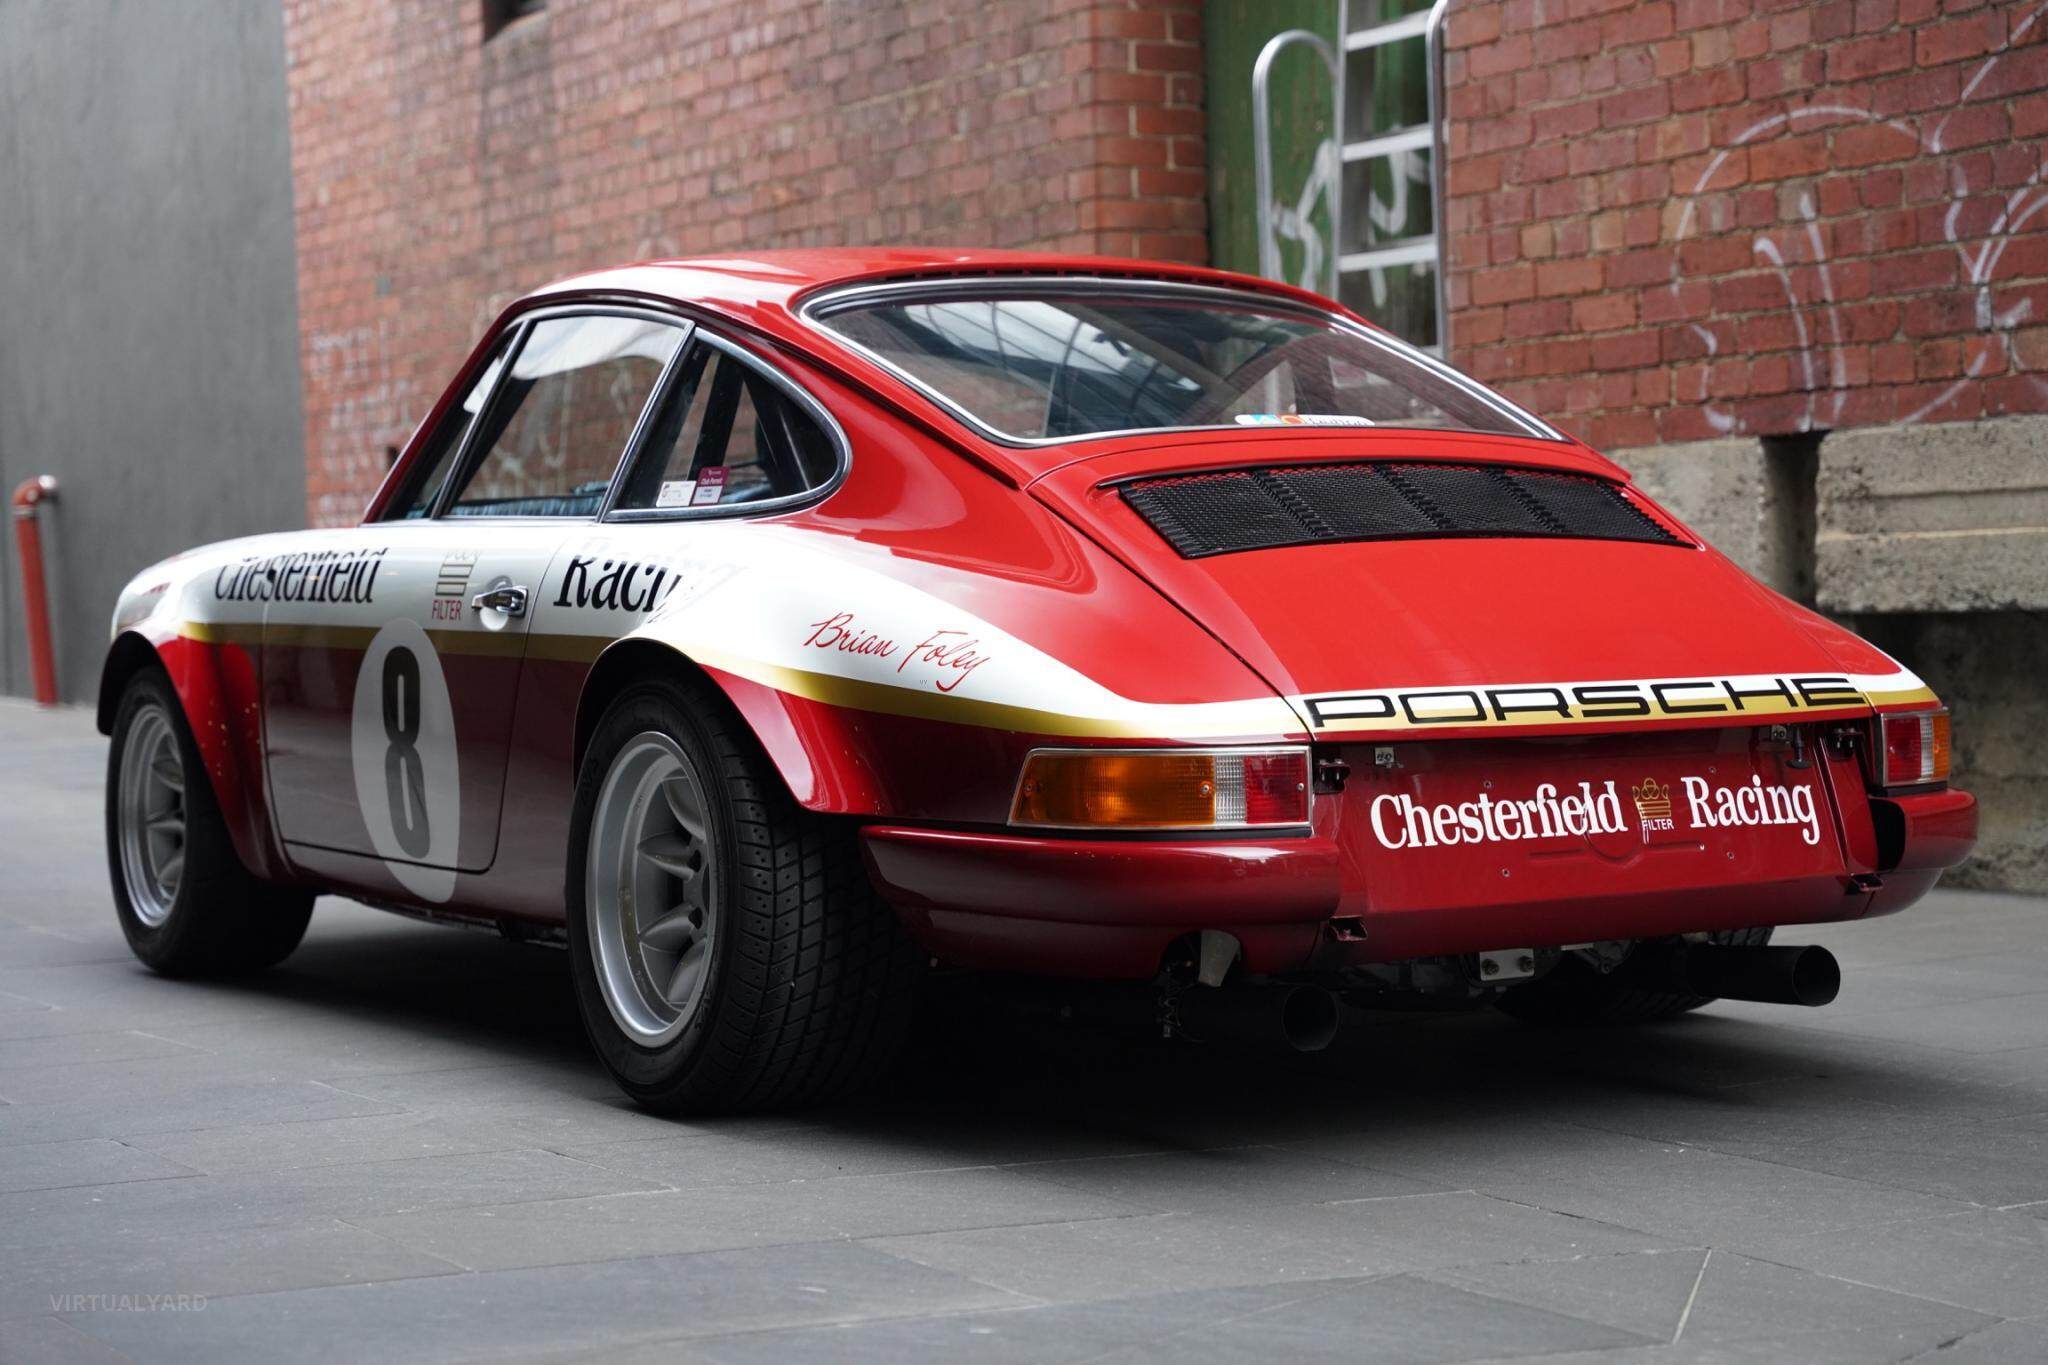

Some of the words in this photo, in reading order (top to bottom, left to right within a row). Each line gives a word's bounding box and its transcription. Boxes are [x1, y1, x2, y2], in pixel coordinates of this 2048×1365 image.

[432, 600, 463, 620] FILTER
[803, 612, 900, 657] Brian
[897, 630, 991, 693] Foley
[1305, 678, 1867, 728] PORSCHE
[382, 645, 430, 859] 8
[1370, 780, 1629, 850] Chesterfield
[1681, 774, 1821, 846] Racing
[1641, 817, 1675, 832] FILTER
